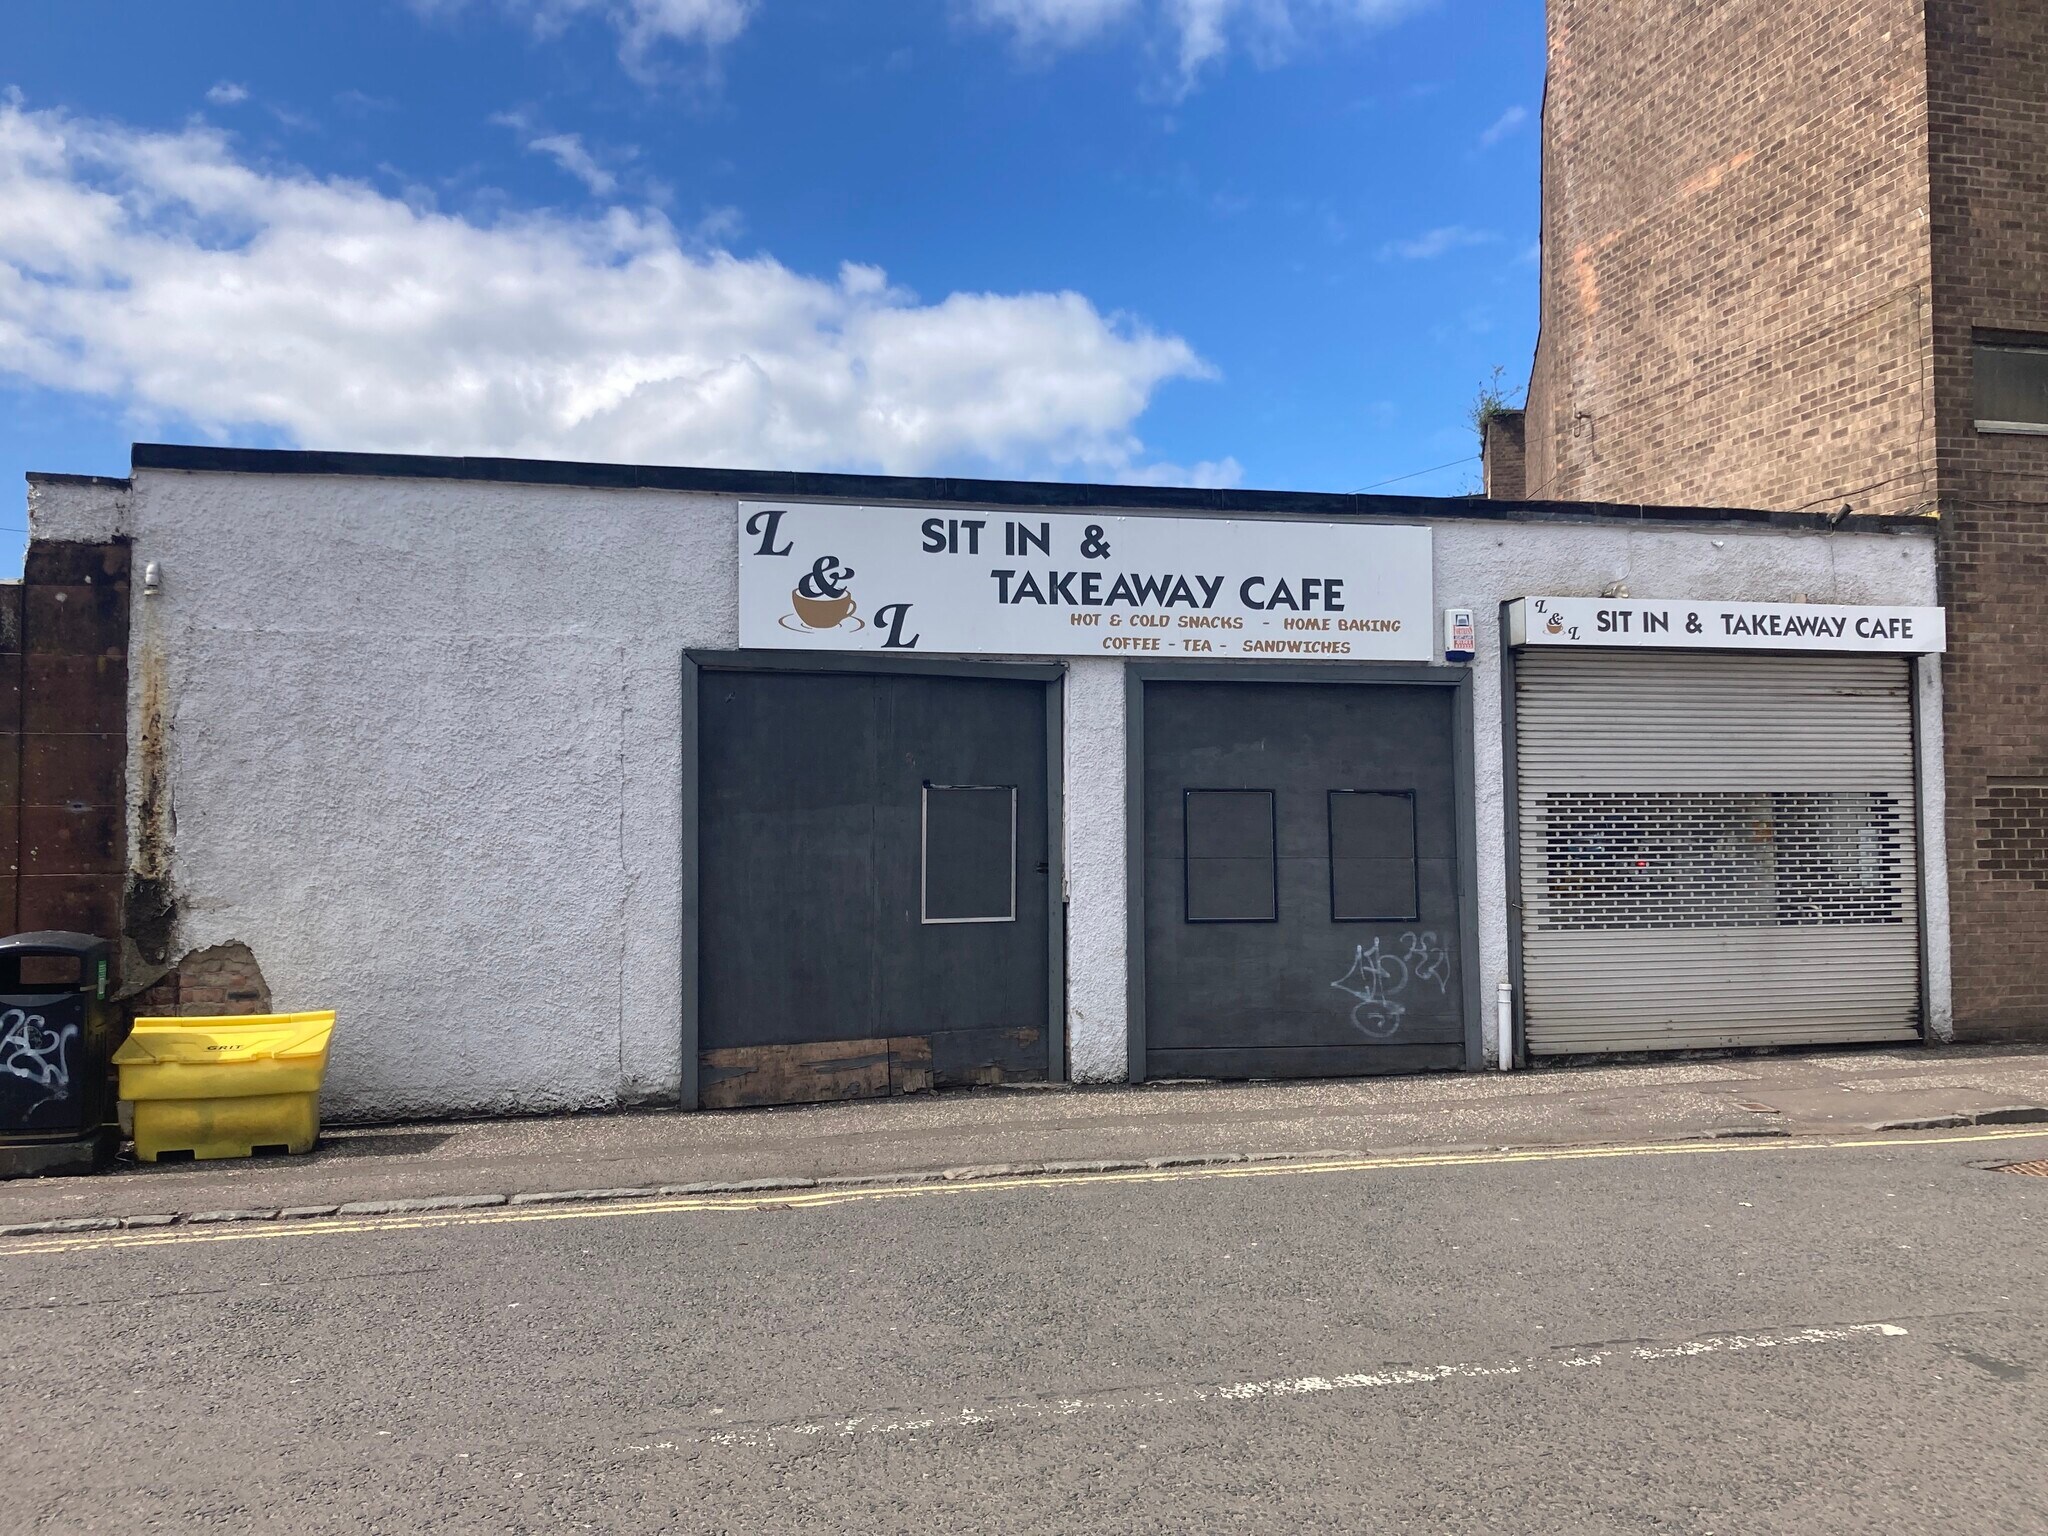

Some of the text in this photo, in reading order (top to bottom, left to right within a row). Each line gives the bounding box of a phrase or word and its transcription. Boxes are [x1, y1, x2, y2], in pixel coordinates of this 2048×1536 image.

[921, 518, 1111, 559] SIT IN &
[746, 511, 920, 648] L & L
[990, 570, 1345, 611] TAKEAWAY CAFE
[1070, 613, 1101, 627] HOT
[1109, 614, 1122, 627] &
[1129, 614, 1170, 628] COLD
[1178, 616, 1243, 629] SNACKS
[1284, 618, 1331, 631] HOME
[1338, 619, 1401, 632] BAKING
[1535, 600, 1581, 640] L & L
[1596, 610, 1914, 639] SIT IN & TAKEAWAY CAFE
[1102, 637, 1161, 650] COFFEE
[1183, 639, 1212, 652] TEA
[1242, 640, 1351, 654] SANDWICHES
